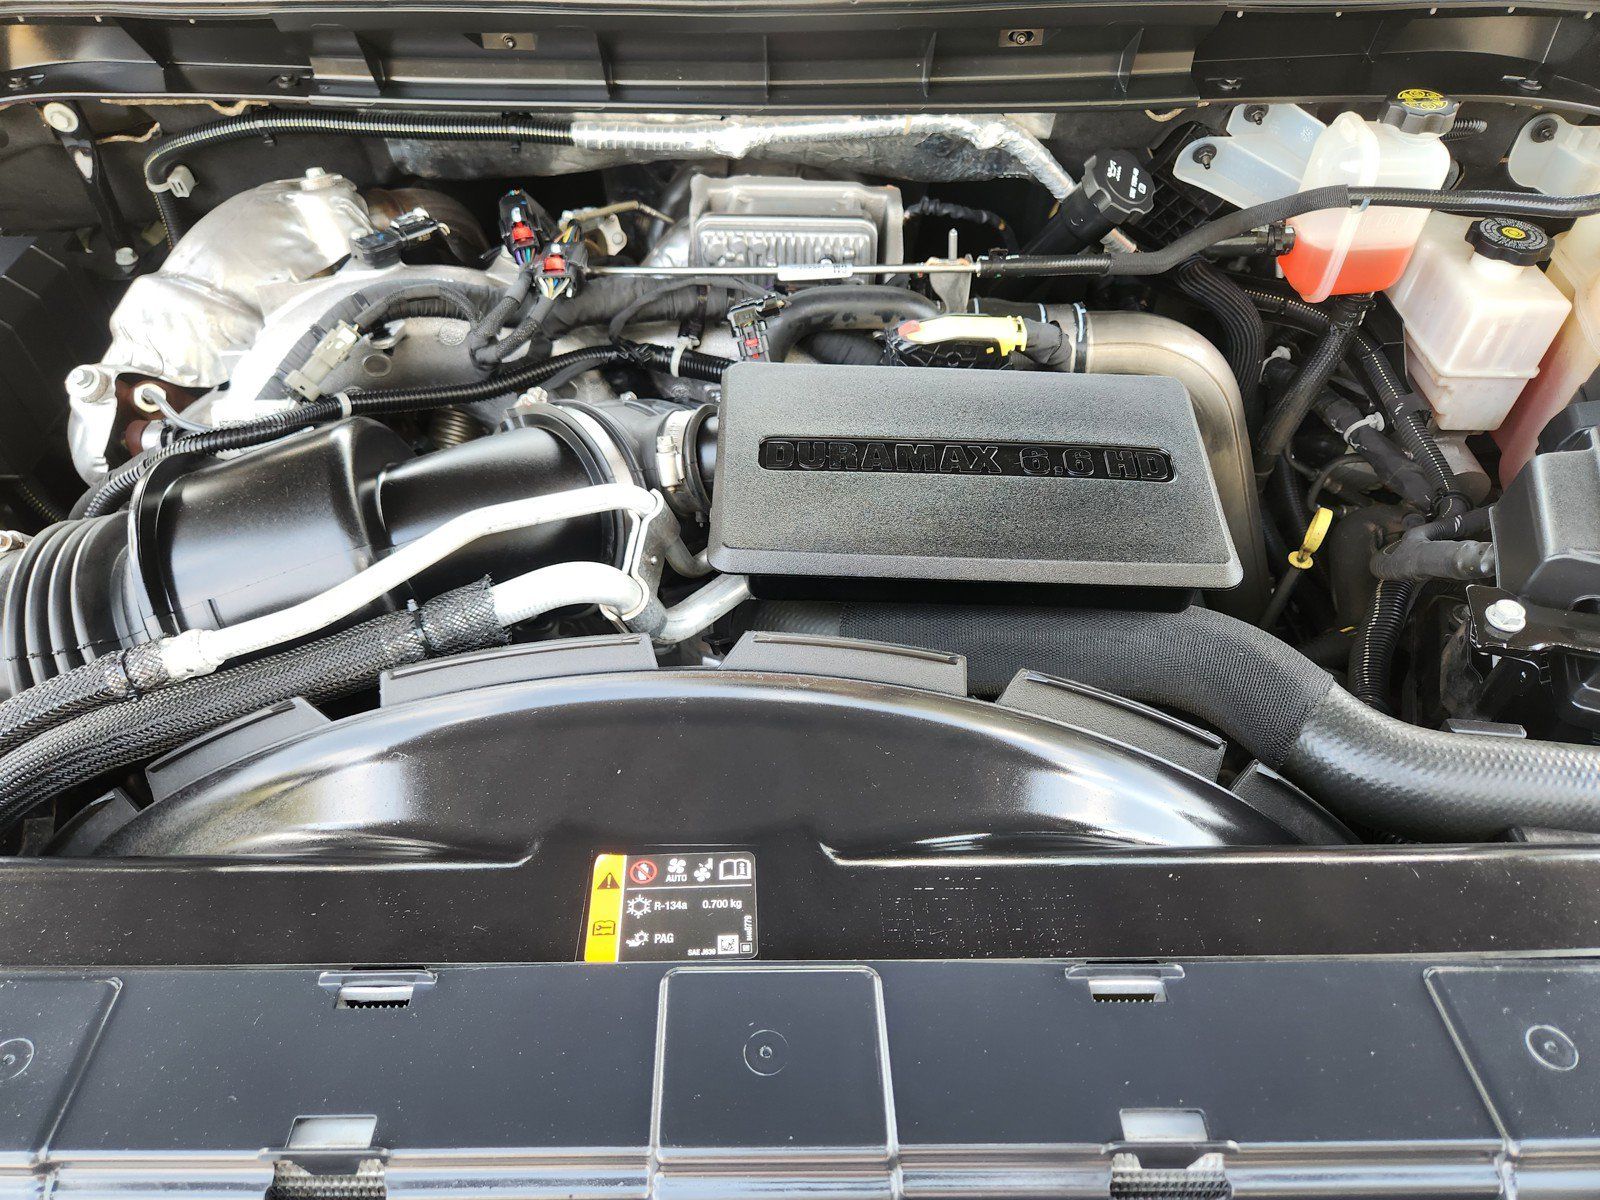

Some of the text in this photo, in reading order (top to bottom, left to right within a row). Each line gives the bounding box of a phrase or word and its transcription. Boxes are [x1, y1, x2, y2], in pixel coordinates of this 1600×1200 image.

[765, 441, 1169, 480] DURAMAX 6.6 HD
[665, 874, 688, 883] AUTO
[653, 898, 743, 911] R-134a 0.700 kg
[653, 933, 675, 944] PAG
